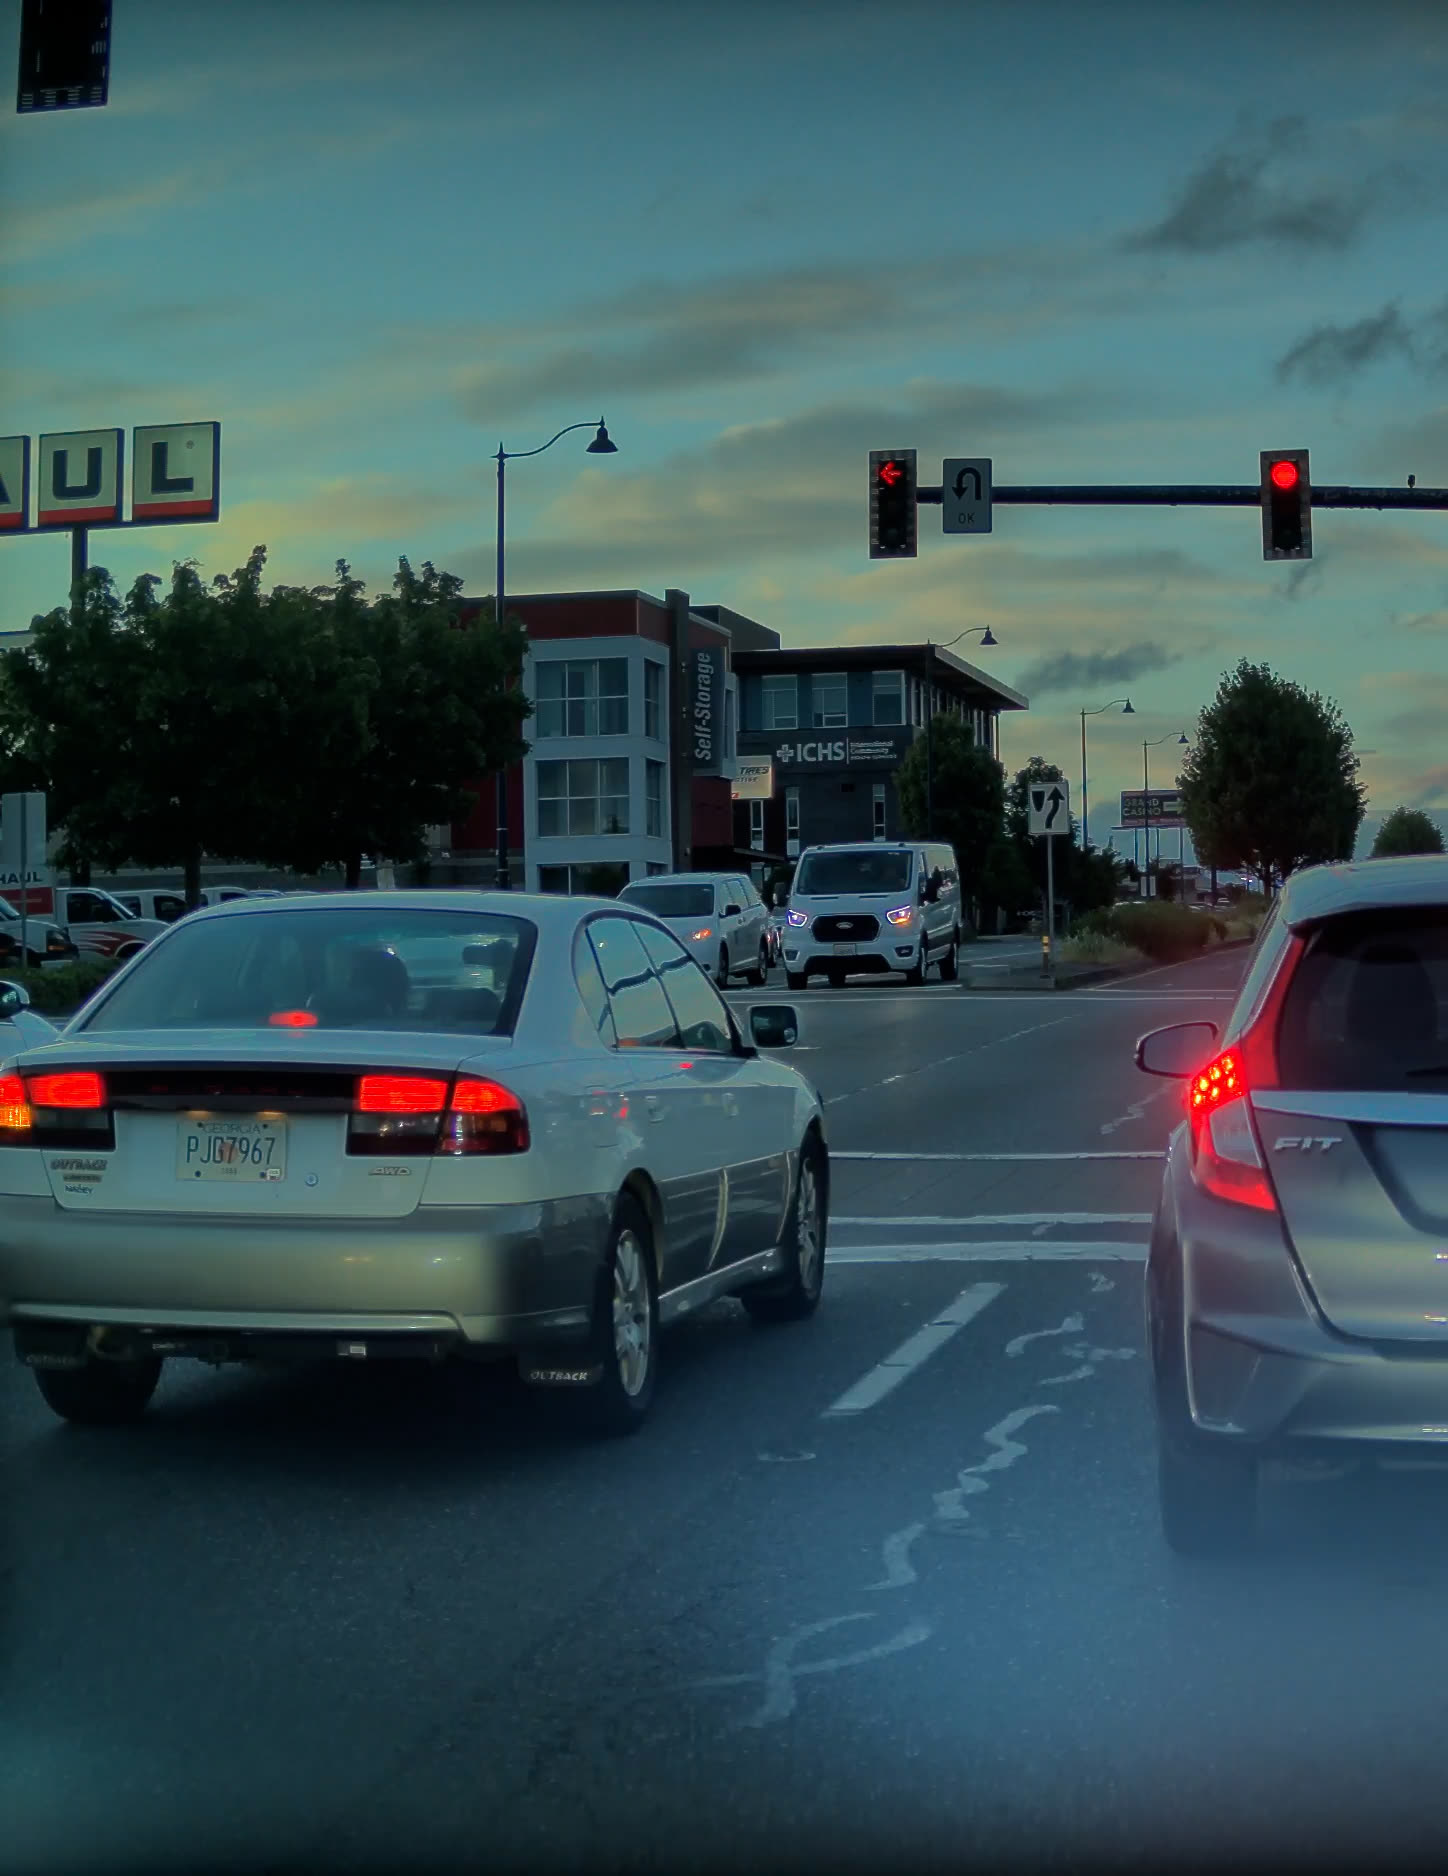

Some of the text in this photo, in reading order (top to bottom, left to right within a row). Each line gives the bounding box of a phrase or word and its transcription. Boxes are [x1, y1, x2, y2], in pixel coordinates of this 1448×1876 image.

[0, 441, 194, 504] UL
[958, 512, 976, 525] OK
[694, 652, 715, 761] Self-Storage
[797, 741, 846, 763] ICHS
[202, 1123, 261, 1135] GEORGIA
[1273, 1136, 1343, 1151] FIT
[51, 1158, 108, 1171] OUTBACK
[529, 1371, 588, 1382] OUTBACK
